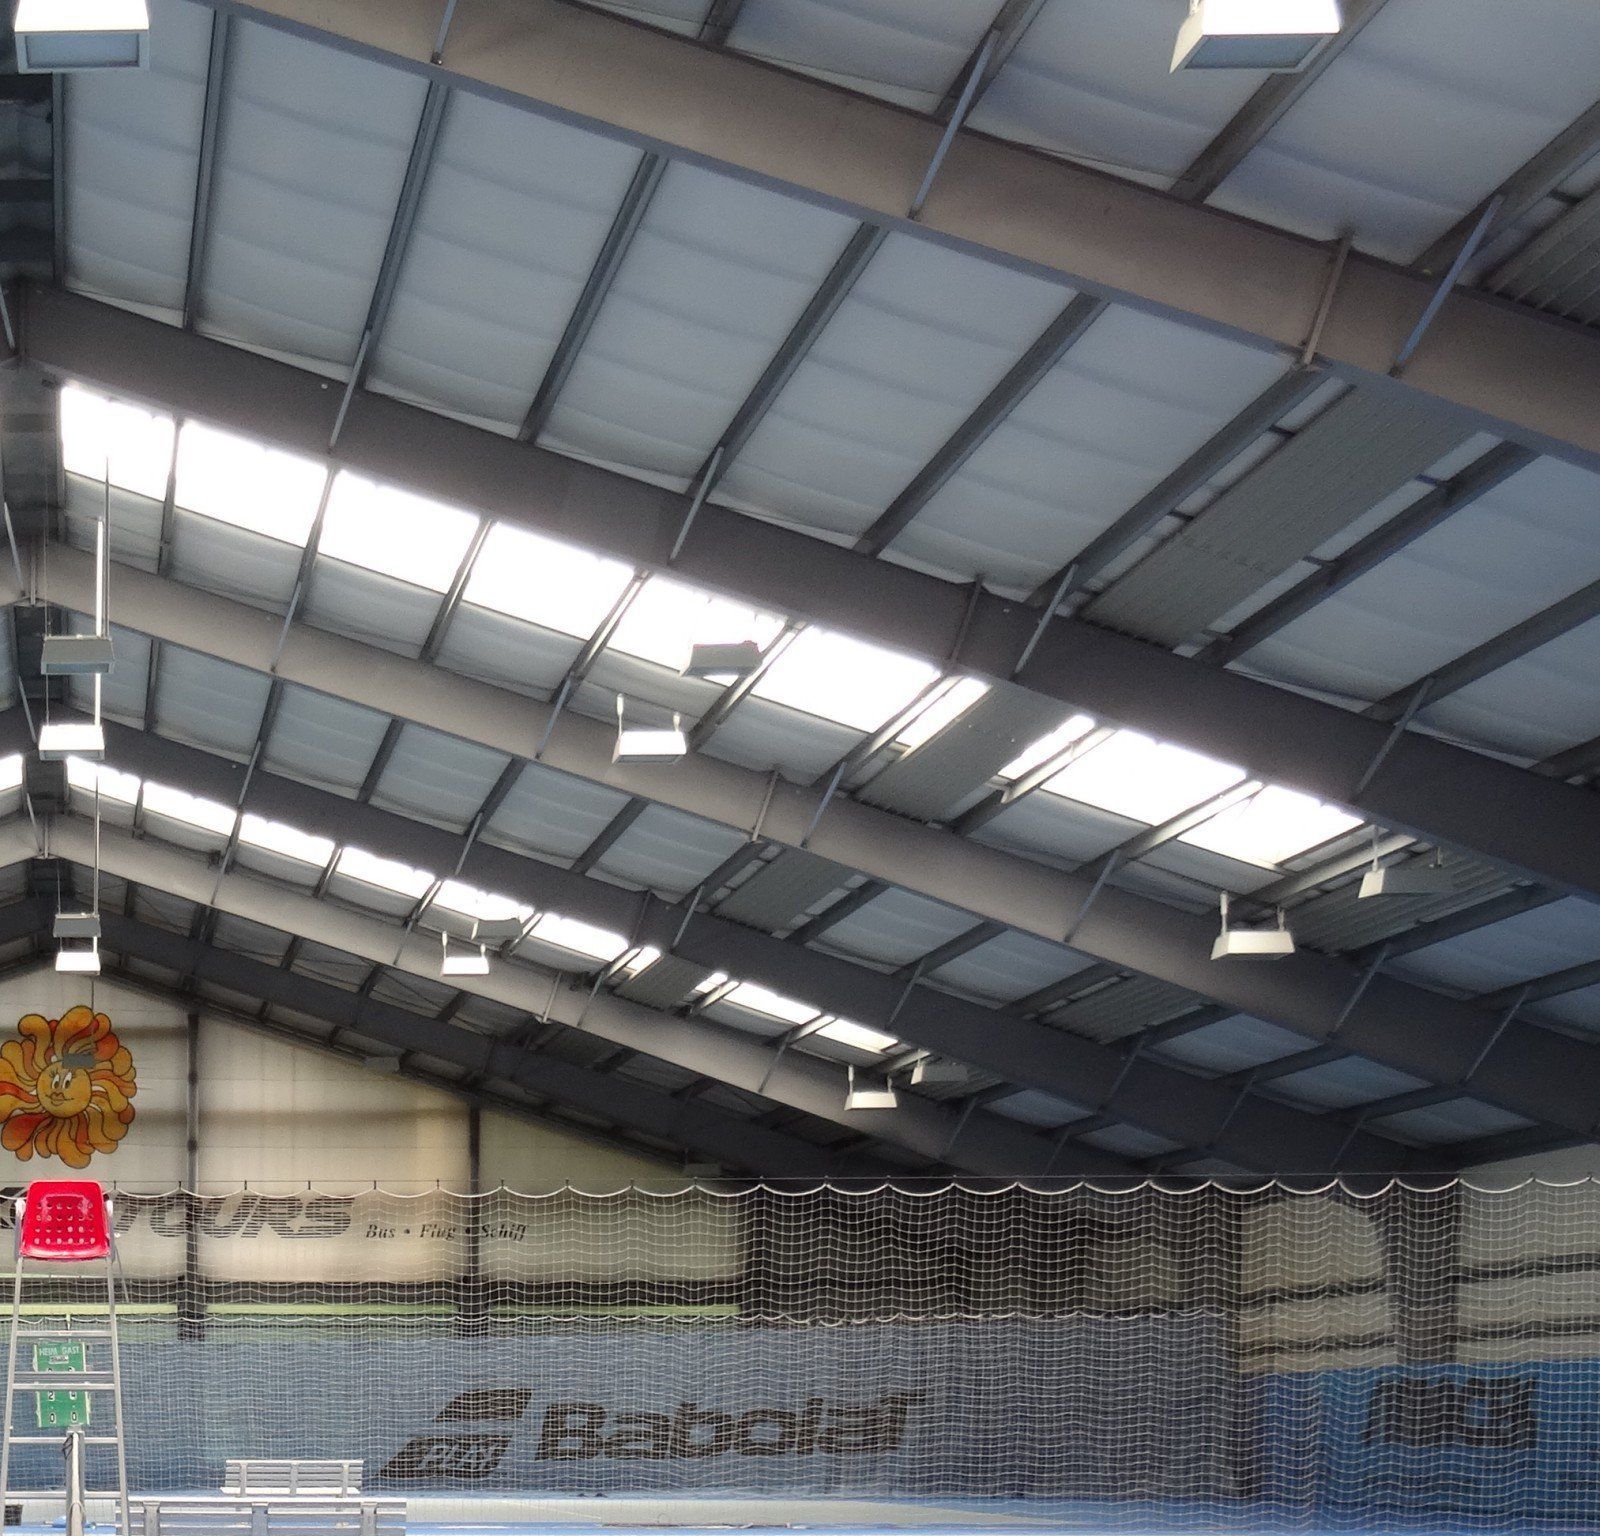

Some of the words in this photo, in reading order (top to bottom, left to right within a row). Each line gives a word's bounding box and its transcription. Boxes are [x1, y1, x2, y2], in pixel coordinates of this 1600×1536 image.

[112, 1193, 355, 1238] TOURS
[366, 1224, 395, 1238] Bus
[420, 1224, 456, 1241] Flug
[480, 1224, 529, 1242] Schiff
[39, 1347, 57, 1356] HEIM
[62, 1346, 80, 1355] GAST
